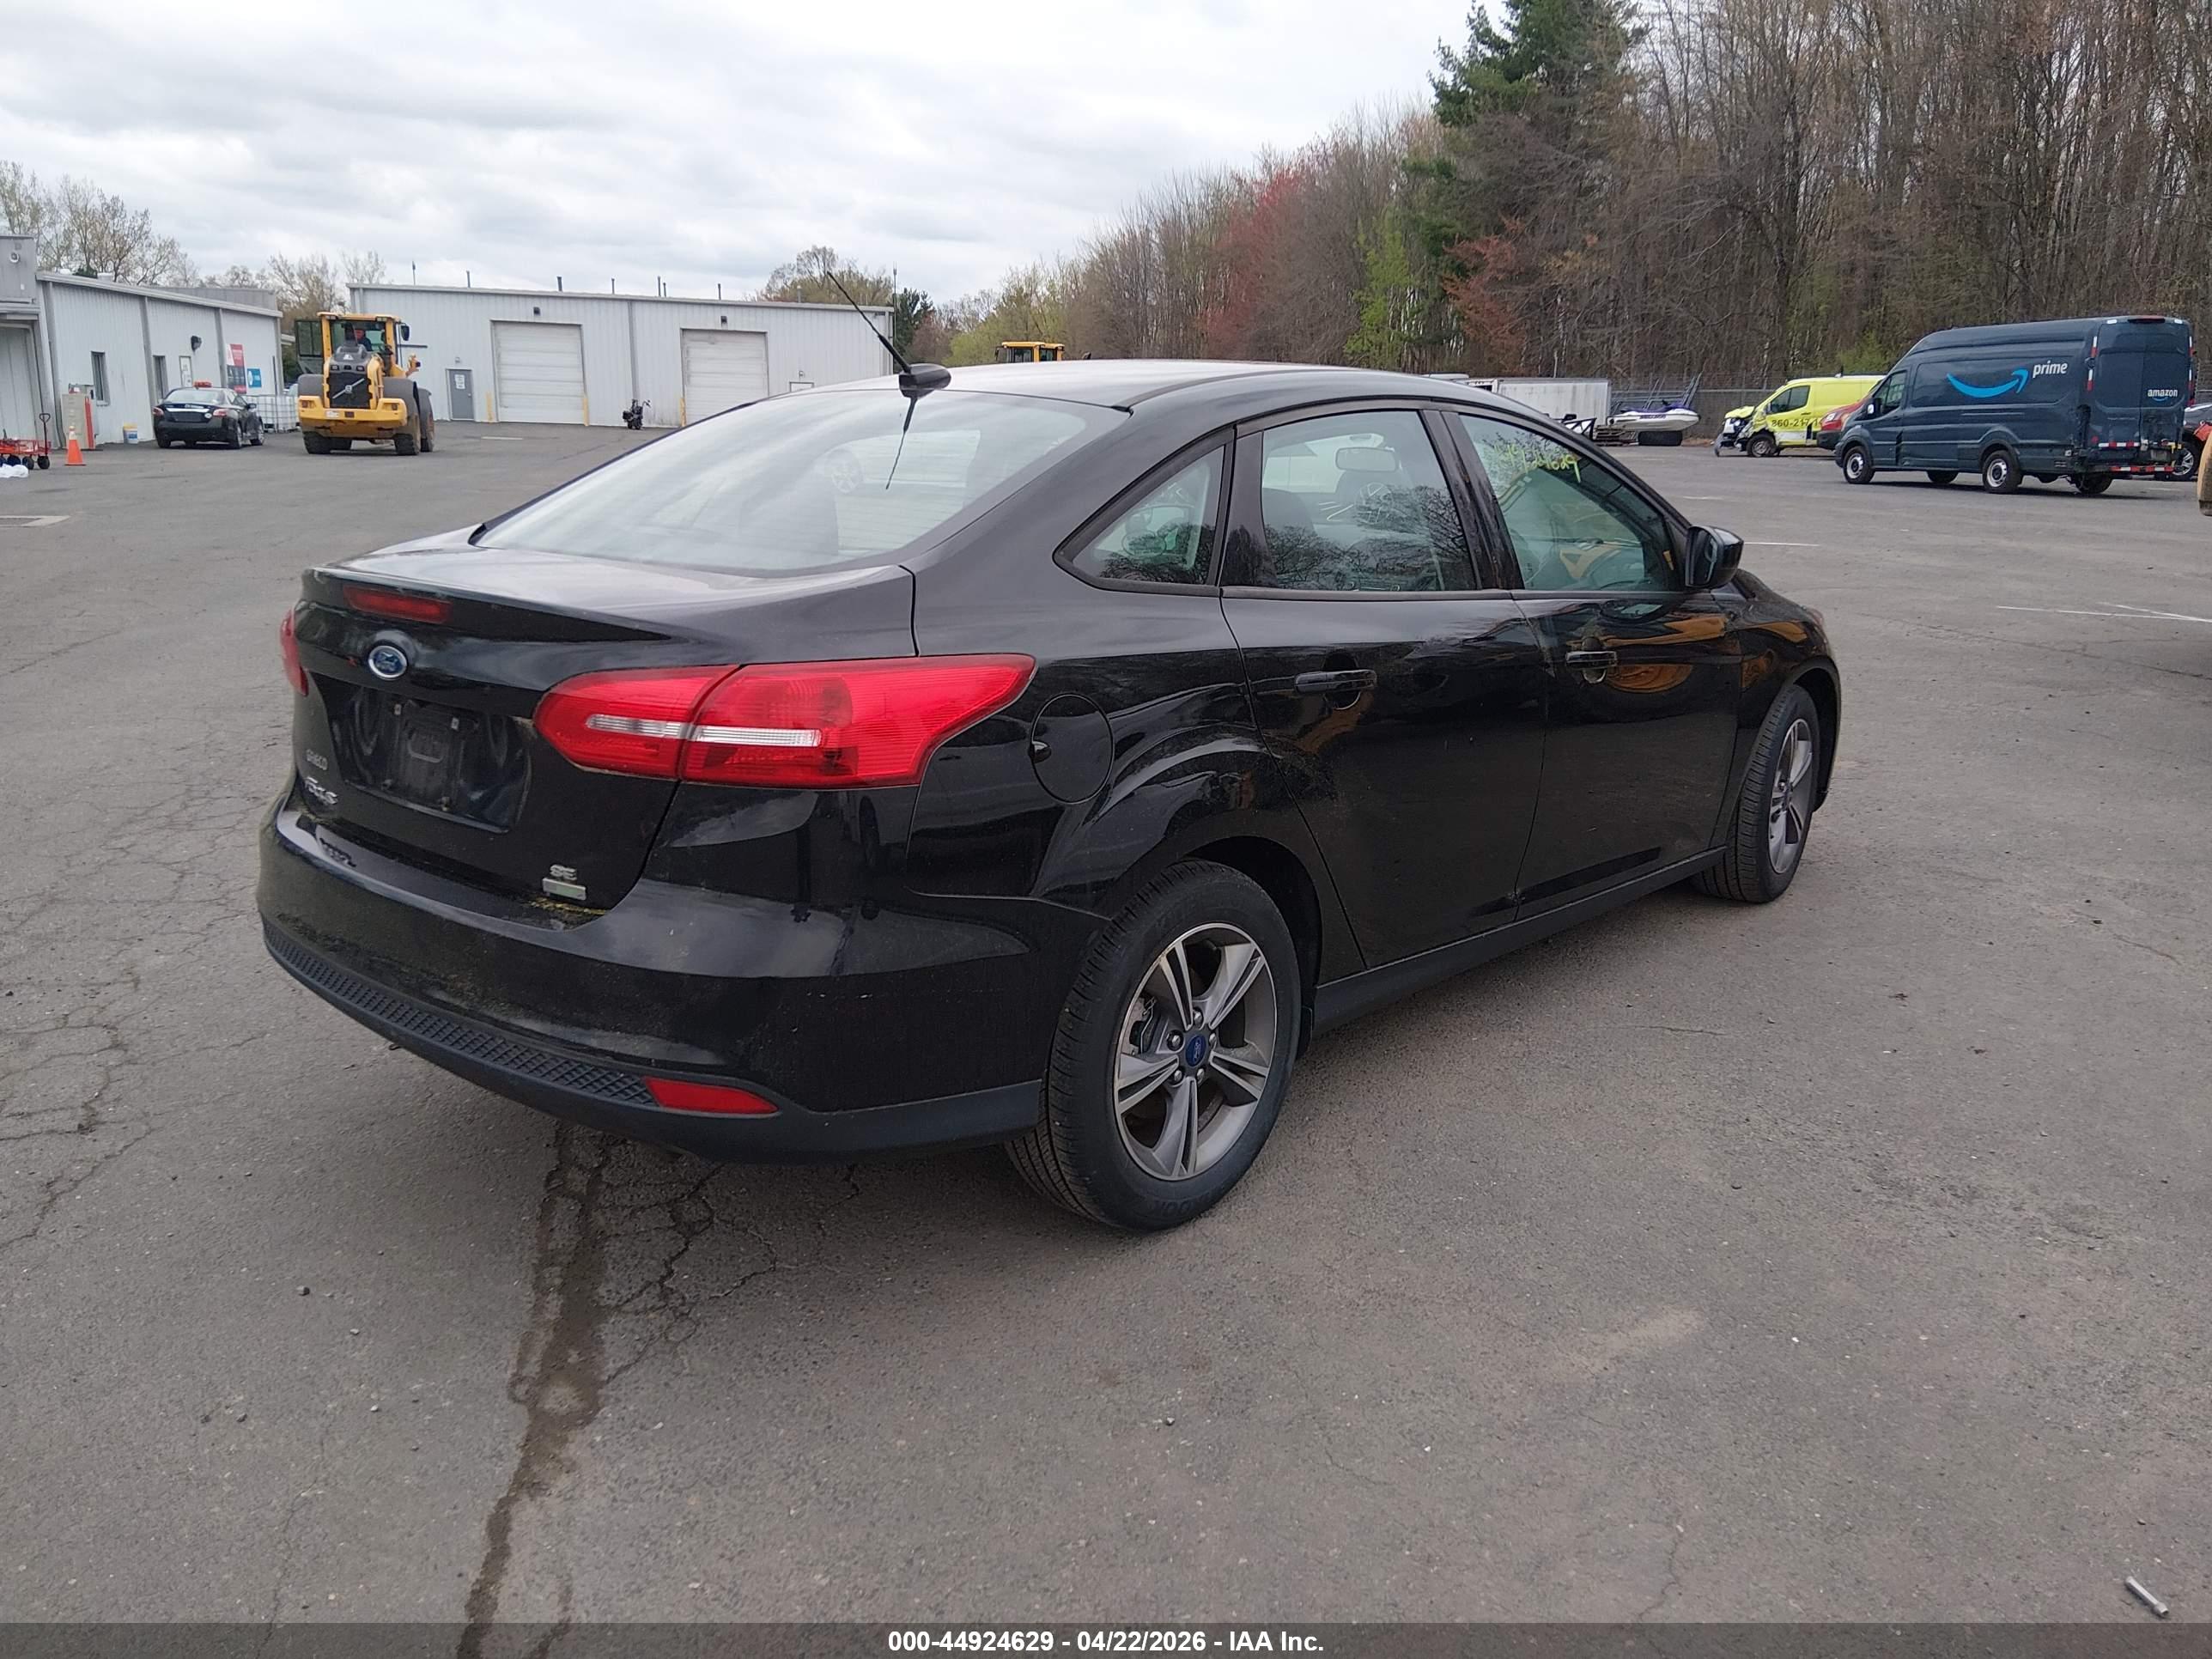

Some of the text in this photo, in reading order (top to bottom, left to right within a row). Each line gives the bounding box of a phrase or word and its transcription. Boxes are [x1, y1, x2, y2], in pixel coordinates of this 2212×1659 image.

[2032, 359, 2069, 379] prime
[2147, 388, 2179, 398] amazon
[550, 864, 578, 881] SE
